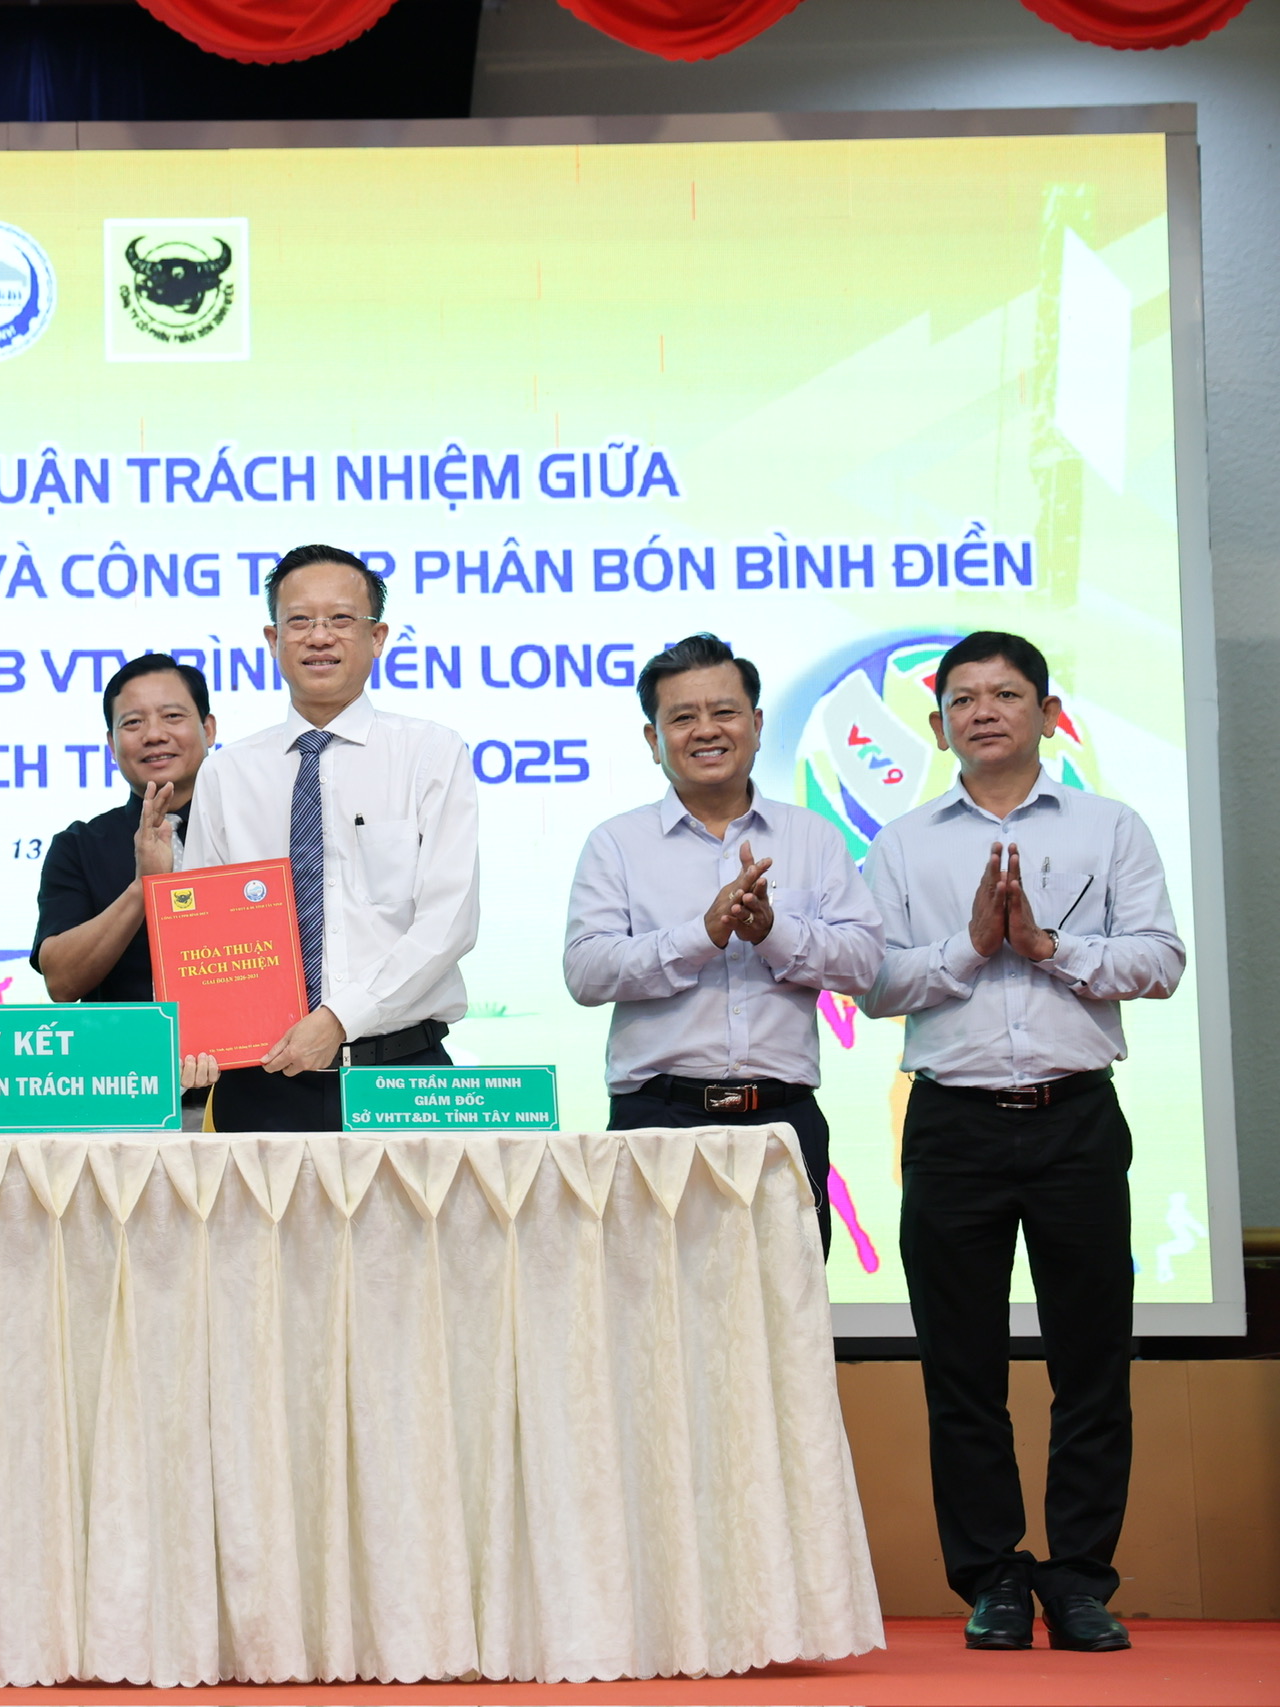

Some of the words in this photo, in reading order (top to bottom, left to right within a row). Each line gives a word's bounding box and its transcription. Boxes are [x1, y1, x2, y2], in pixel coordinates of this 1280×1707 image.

[127, 447, 314, 502] TRÁCH
[338, 444, 519, 510] NHIỆM
[539, 443, 679, 498] GIỮA
[62, 542, 219, 598] CÔNG
[416, 537, 572, 593] PHÂN
[594, 535, 714, 591] BÓN
[737, 533, 873, 589] BÌNH
[893, 522, 1031, 587] ĐIỀN
[371, 626, 460, 689] IỀN
[482, 644, 634, 688] LONG
[473, 740, 589, 784] 025
[180, 945, 222, 961] THỎA
[223, 940, 273, 956] THUẬN
[178, 961, 228, 977] TRÁCH
[231, 955, 280, 971] NHIỆM
[15, 1022, 74, 1055] KẾT
[16, 1072, 84, 1096] TRÁCH
[92, 1071, 158, 1098] NHIỆM
[376, 1076, 405, 1089] ÔNG
[409, 1074, 447, 1088] TRẦN
[452, 1078, 480, 1087] ANH
[485, 1078, 521, 1087] MINH
[415, 1093, 450, 1105] GIÁM
[455, 1092, 484, 1105] ĐỐC
[352, 1109, 371, 1122] SỞ
[376, 1113, 440, 1122] VHTT&DL
[445, 1109, 478, 1122] TỈNH
[482, 1110, 510, 1122] TÂY
[516, 1112, 549, 1122] NINH
